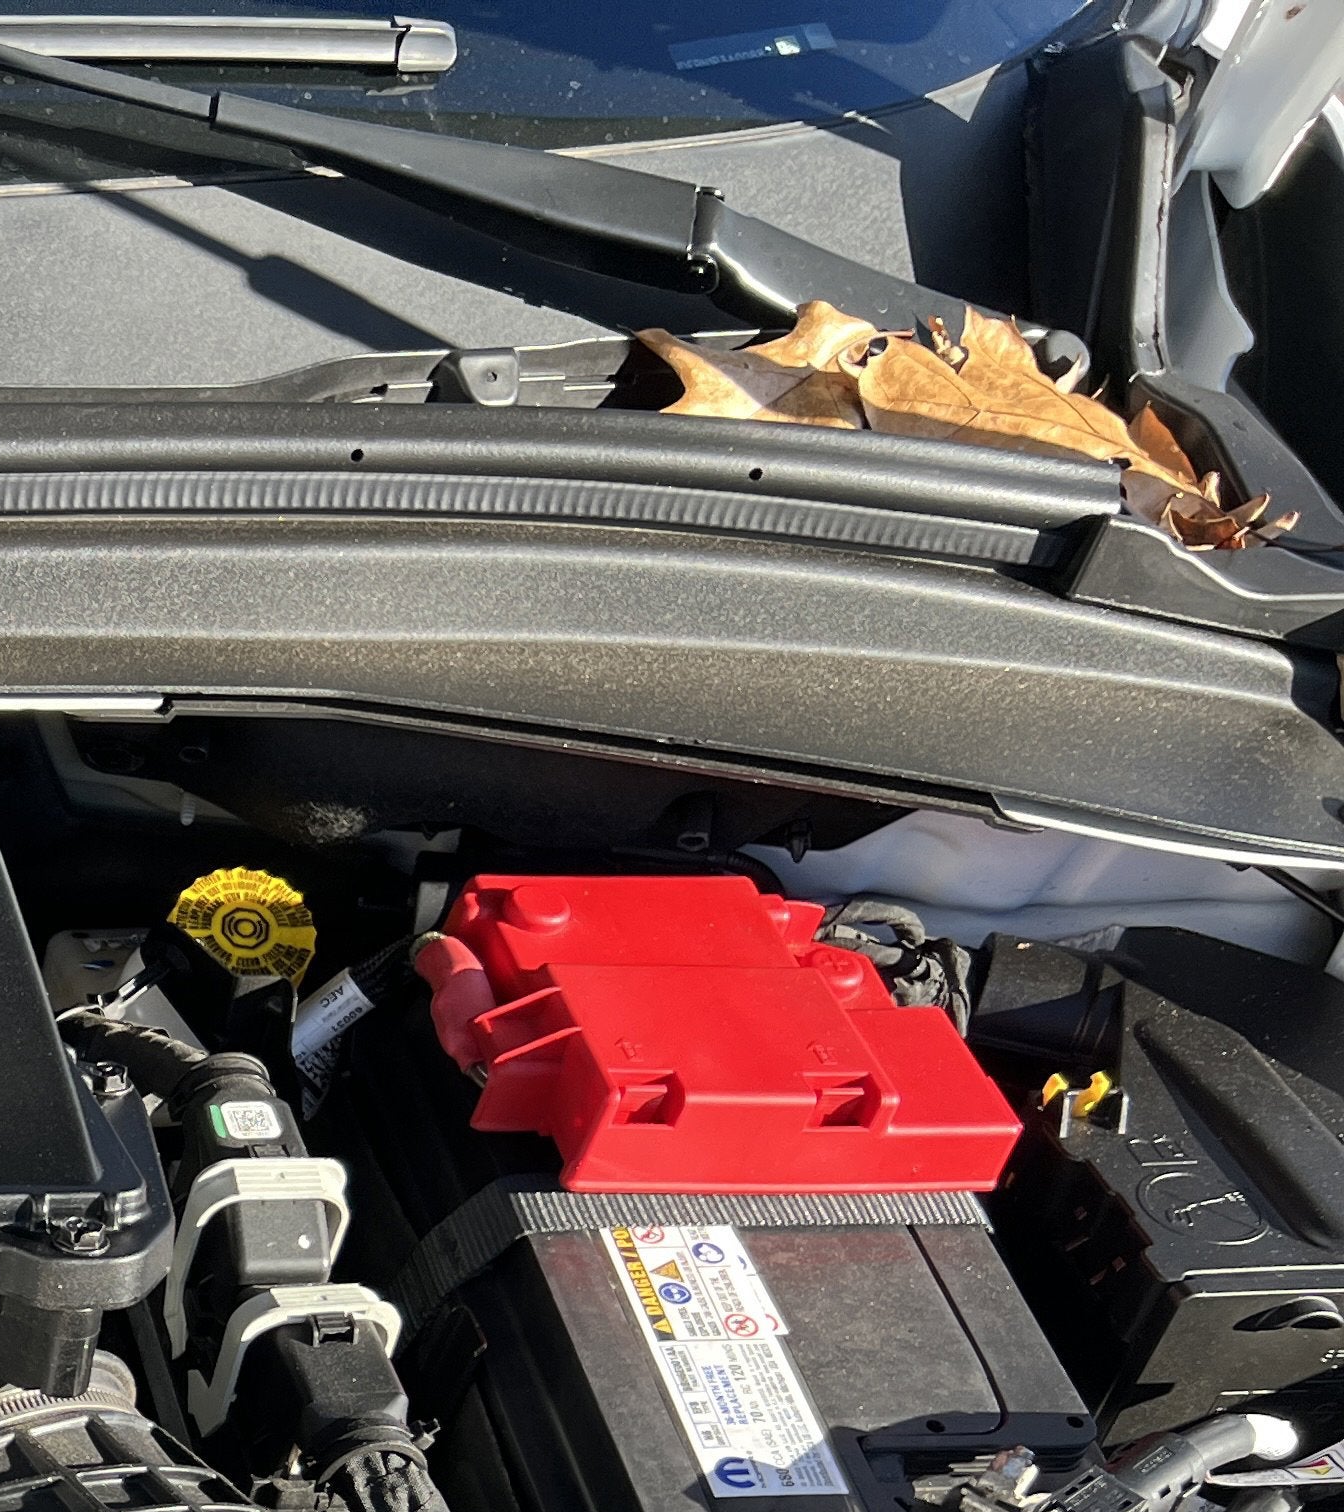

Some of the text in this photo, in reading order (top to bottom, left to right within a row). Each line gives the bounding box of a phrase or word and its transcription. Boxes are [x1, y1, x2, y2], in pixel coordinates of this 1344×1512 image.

[319, 984, 345, 1009] AEC
[625, 1262, 663, 1314] DANGER
[727, 1364, 747, 1380] 120
[713, 1364, 749, 1424] REPLACEMENT
[774, 1467, 796, 1487] 680
